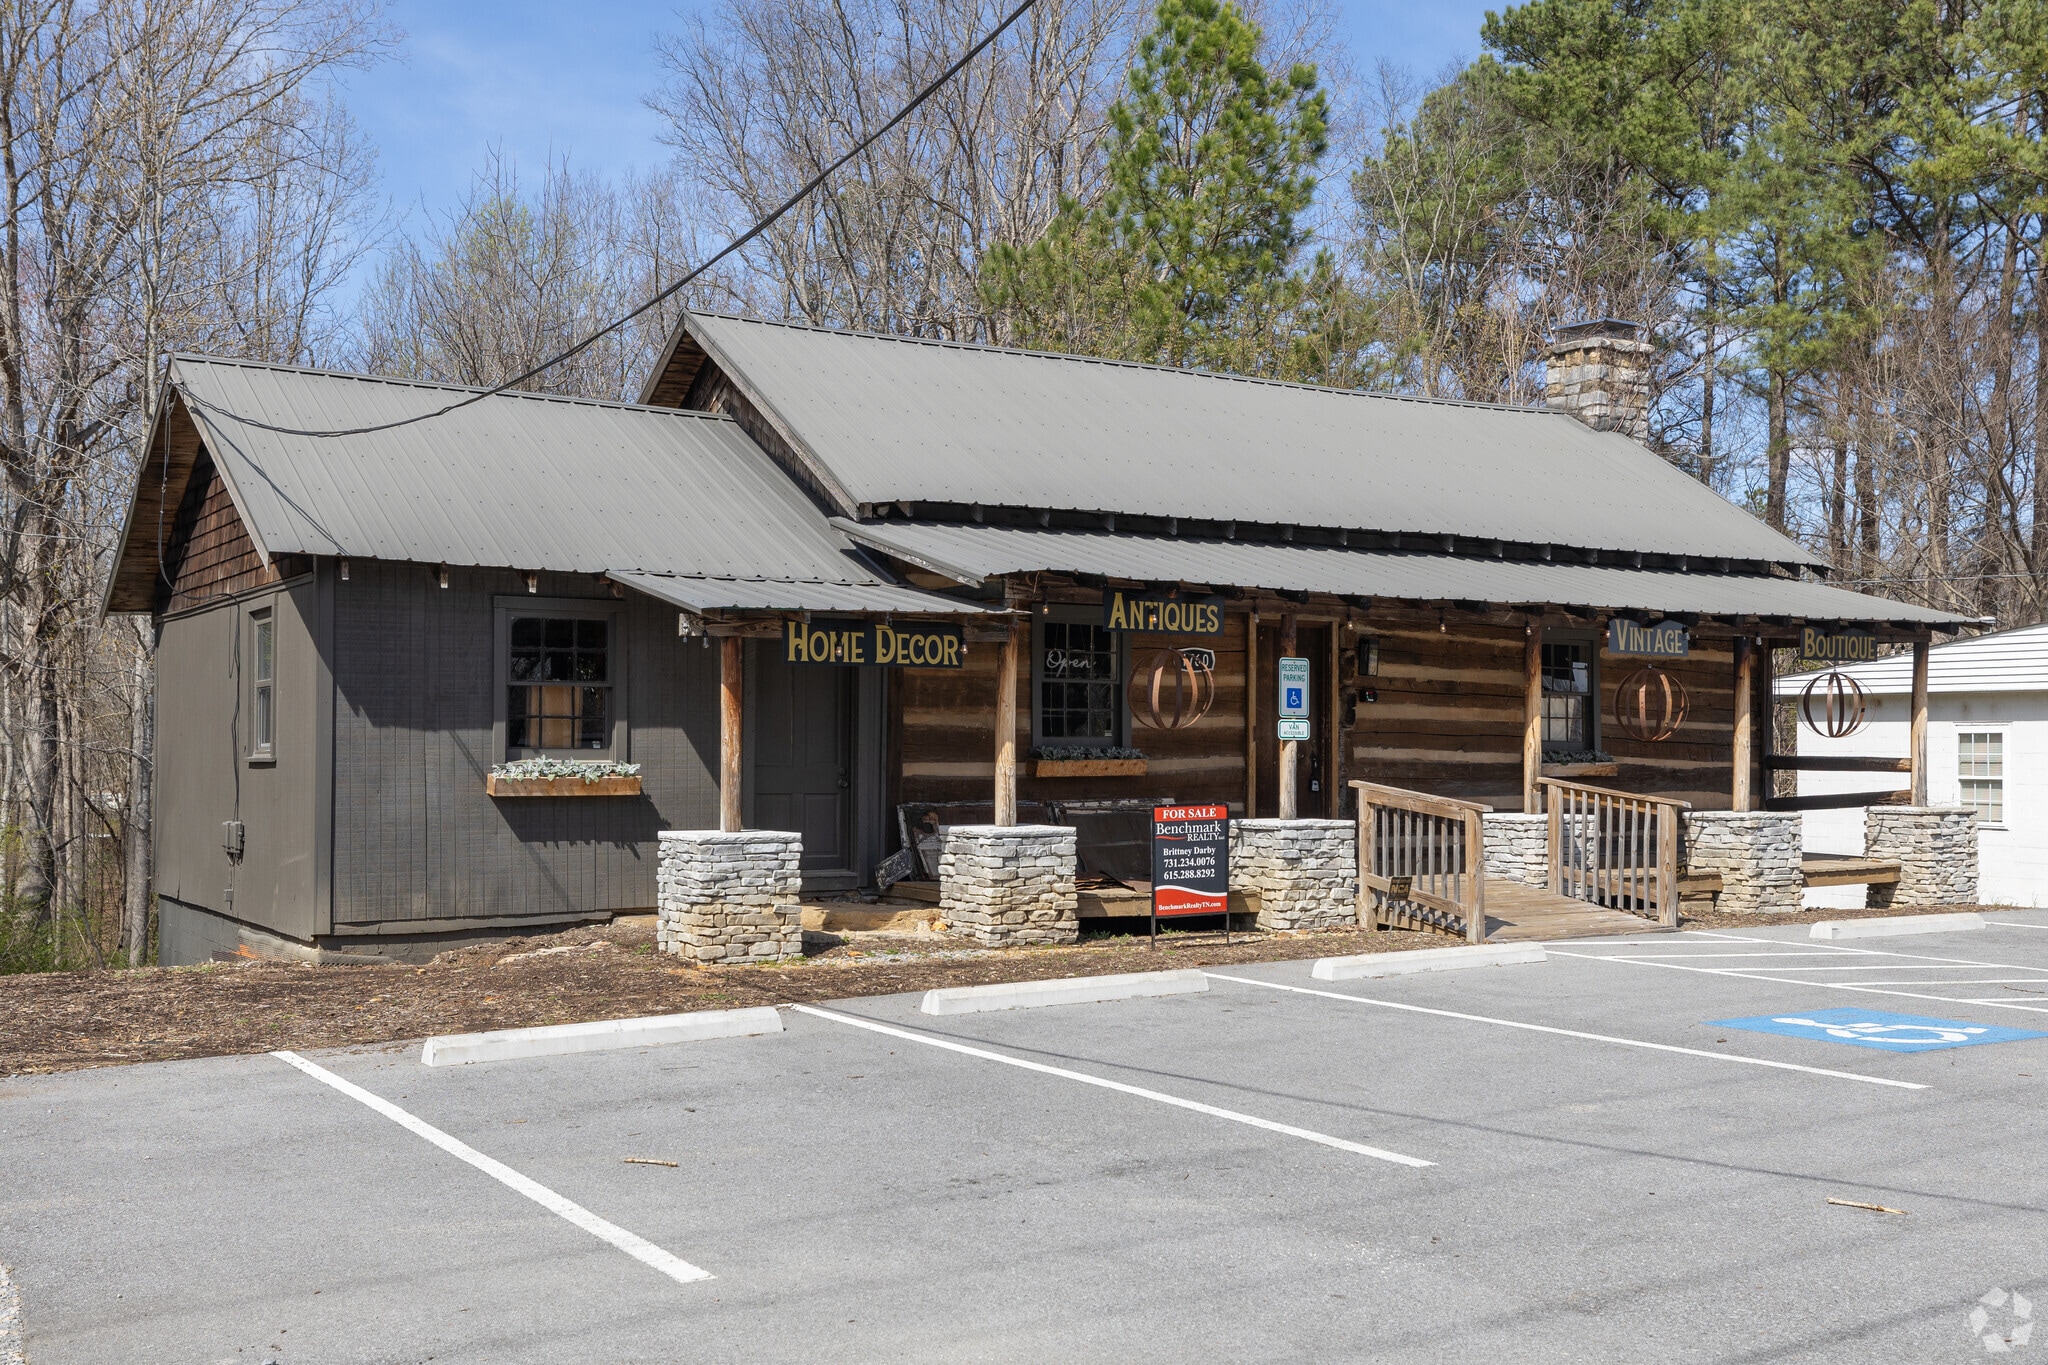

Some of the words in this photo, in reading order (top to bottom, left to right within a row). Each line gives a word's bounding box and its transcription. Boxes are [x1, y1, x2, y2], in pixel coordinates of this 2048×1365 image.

[1108, 592, 1219, 633] ANTIQUES
[1615, 619, 1684, 654] VINTAGE
[787, 621, 865, 663] HOME
[875, 624, 959, 666] DECOR
[1804, 628, 1876, 659] BOUTIQUE
[1046, 648, 1097, 678] Open
[1281, 664, 1306, 672] RESERVED
[1283, 674, 1305, 682] PARKING
[1163, 810, 1186, 819] FOR
[1188, 808, 1216, 818] SALE
[1156, 821, 1221, 835] Benchmark
[1187, 833, 1219, 841] REALTY
[1163, 847, 1192, 857] Brittney
[1193, 846, 1216, 856] Darby
[1164, 857, 1215, 867] 731.234.0076
[1164, 869, 1215, 880] 615.288.8292
[1158, 902, 1221, 910] BenchmarkRealtyTN.com
